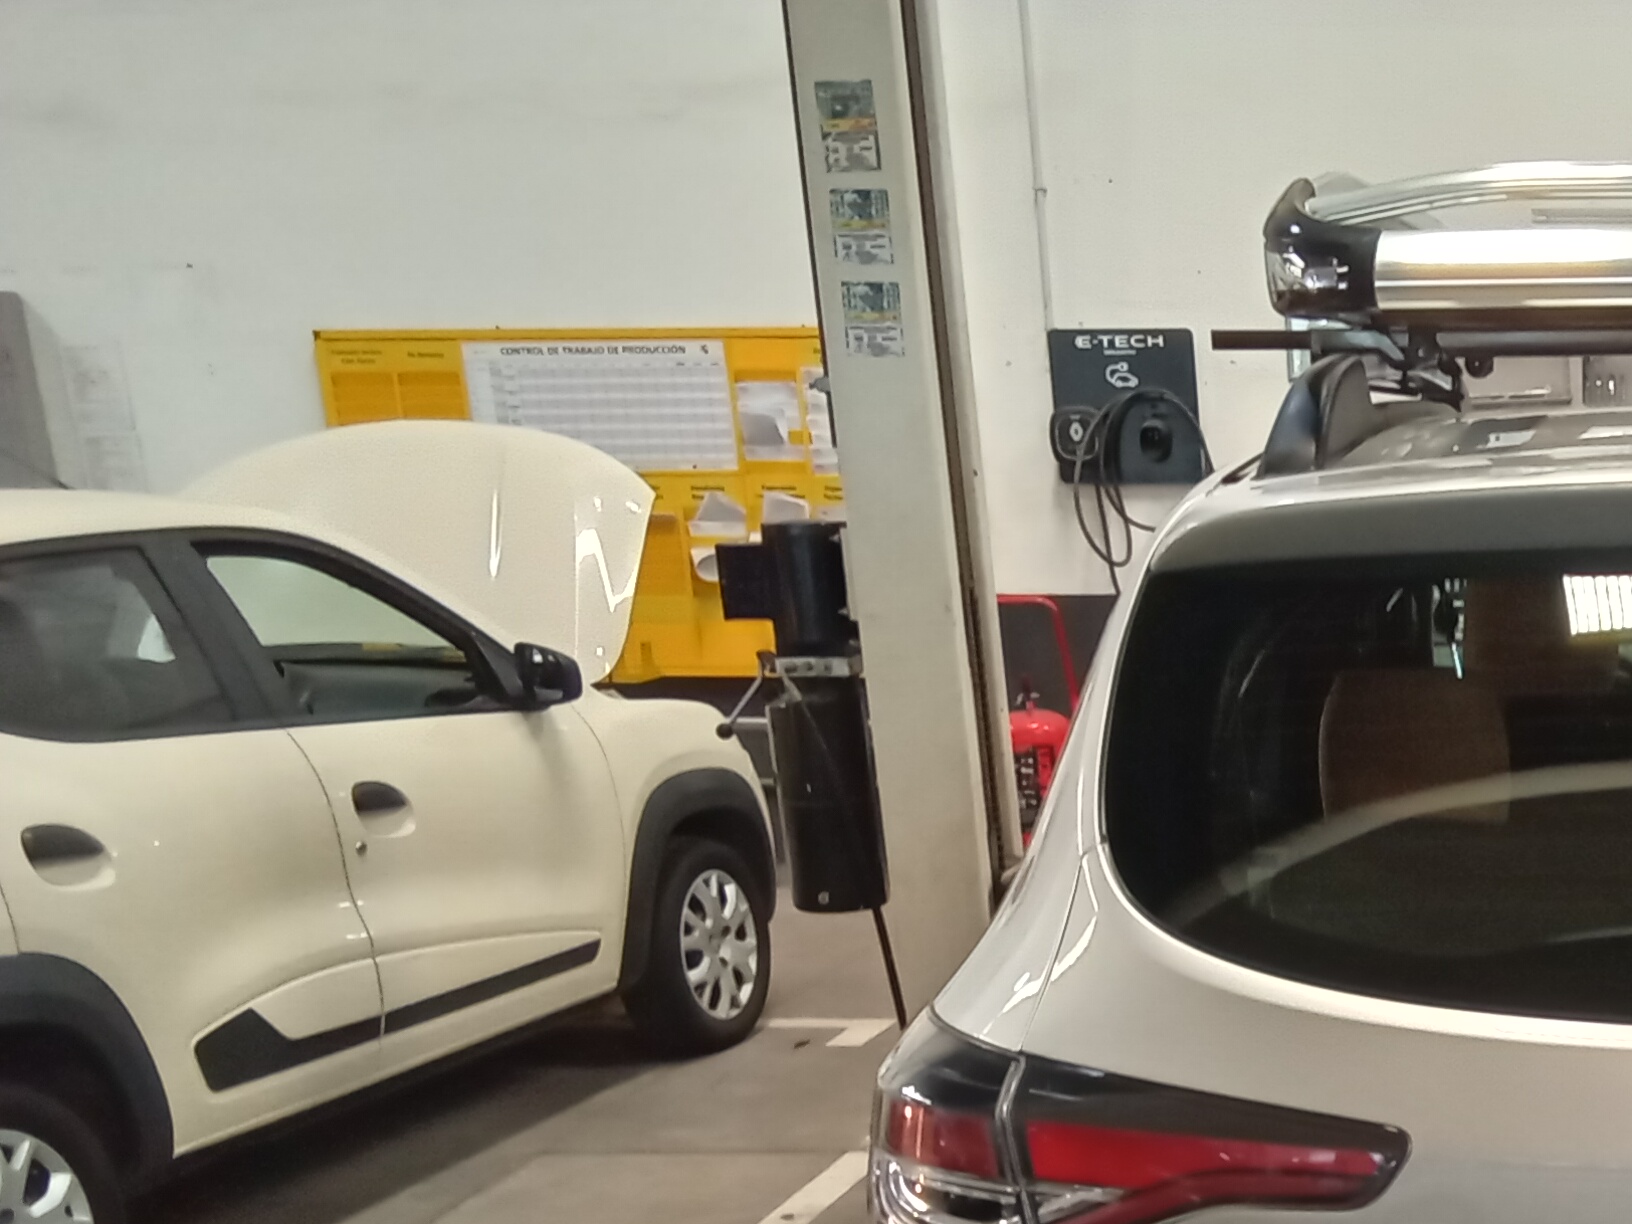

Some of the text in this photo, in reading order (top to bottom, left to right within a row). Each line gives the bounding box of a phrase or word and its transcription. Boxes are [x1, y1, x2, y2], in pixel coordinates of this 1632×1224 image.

[1074, 334, 1165, 349] E-TECH
[500, 346, 544, 356] CONTROL
[546, 346, 559, 356] DE
[562, 346, 605, 356] TRABAJO
[607, 345, 619, 355] DE
